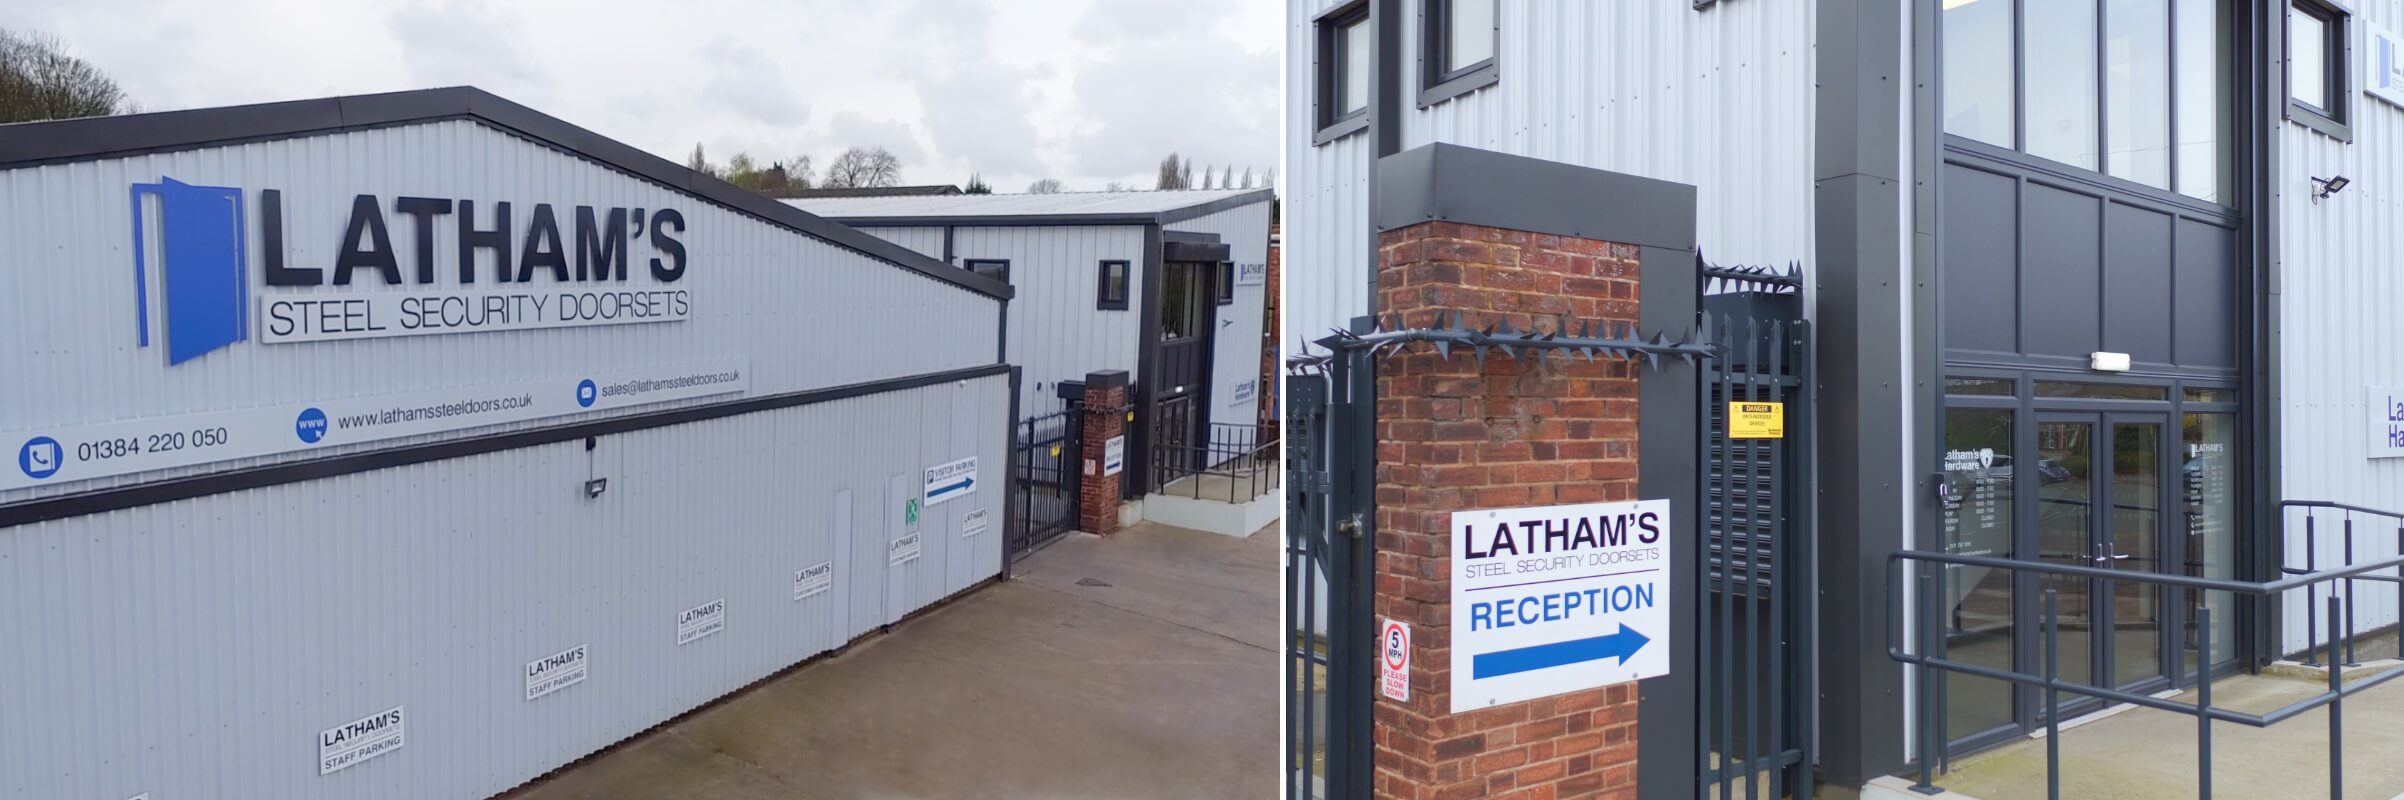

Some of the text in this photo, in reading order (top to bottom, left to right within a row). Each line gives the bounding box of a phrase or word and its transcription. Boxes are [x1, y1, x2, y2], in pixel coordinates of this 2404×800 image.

[262, 188, 687, 287] LATHAM'S
[269, 290, 689, 337] STEEL SECURITY DOORSETS
[602, 368, 740, 397] sales@lathamssteeldoors.co.uk
[338, 392, 533, 430] www.lathamssteeldoors.co.uk
[78, 427, 228, 462] 01384 220 050
[1945, 449, 1980, 460] atham's
[1465, 511, 1660, 560] LATHAM'S
[796, 562, 830, 582] LATHAM'S
[1465, 548, 1660, 579] STEEL SECURITY DOORSETS
[680, 600, 722, 624] LATHAM'S
[1471, 582, 1654, 632] RECEPTION
[1388, 648, 1403, 659] MPH
[1391, 630, 1400, 649] 5
[529, 647, 584, 676] LATHAM'S
[1384, 669, 1407, 682] PLEASE
[529, 681, 552, 697] STAFF
[553, 669, 584, 687] PARKING
[1386, 679, 1404, 690] SLOW
[1386, 687, 1405, 699] DOWN
[324, 710, 400, 747] LATHAM'S
[325, 735, 401, 770] STAFF PARKING
